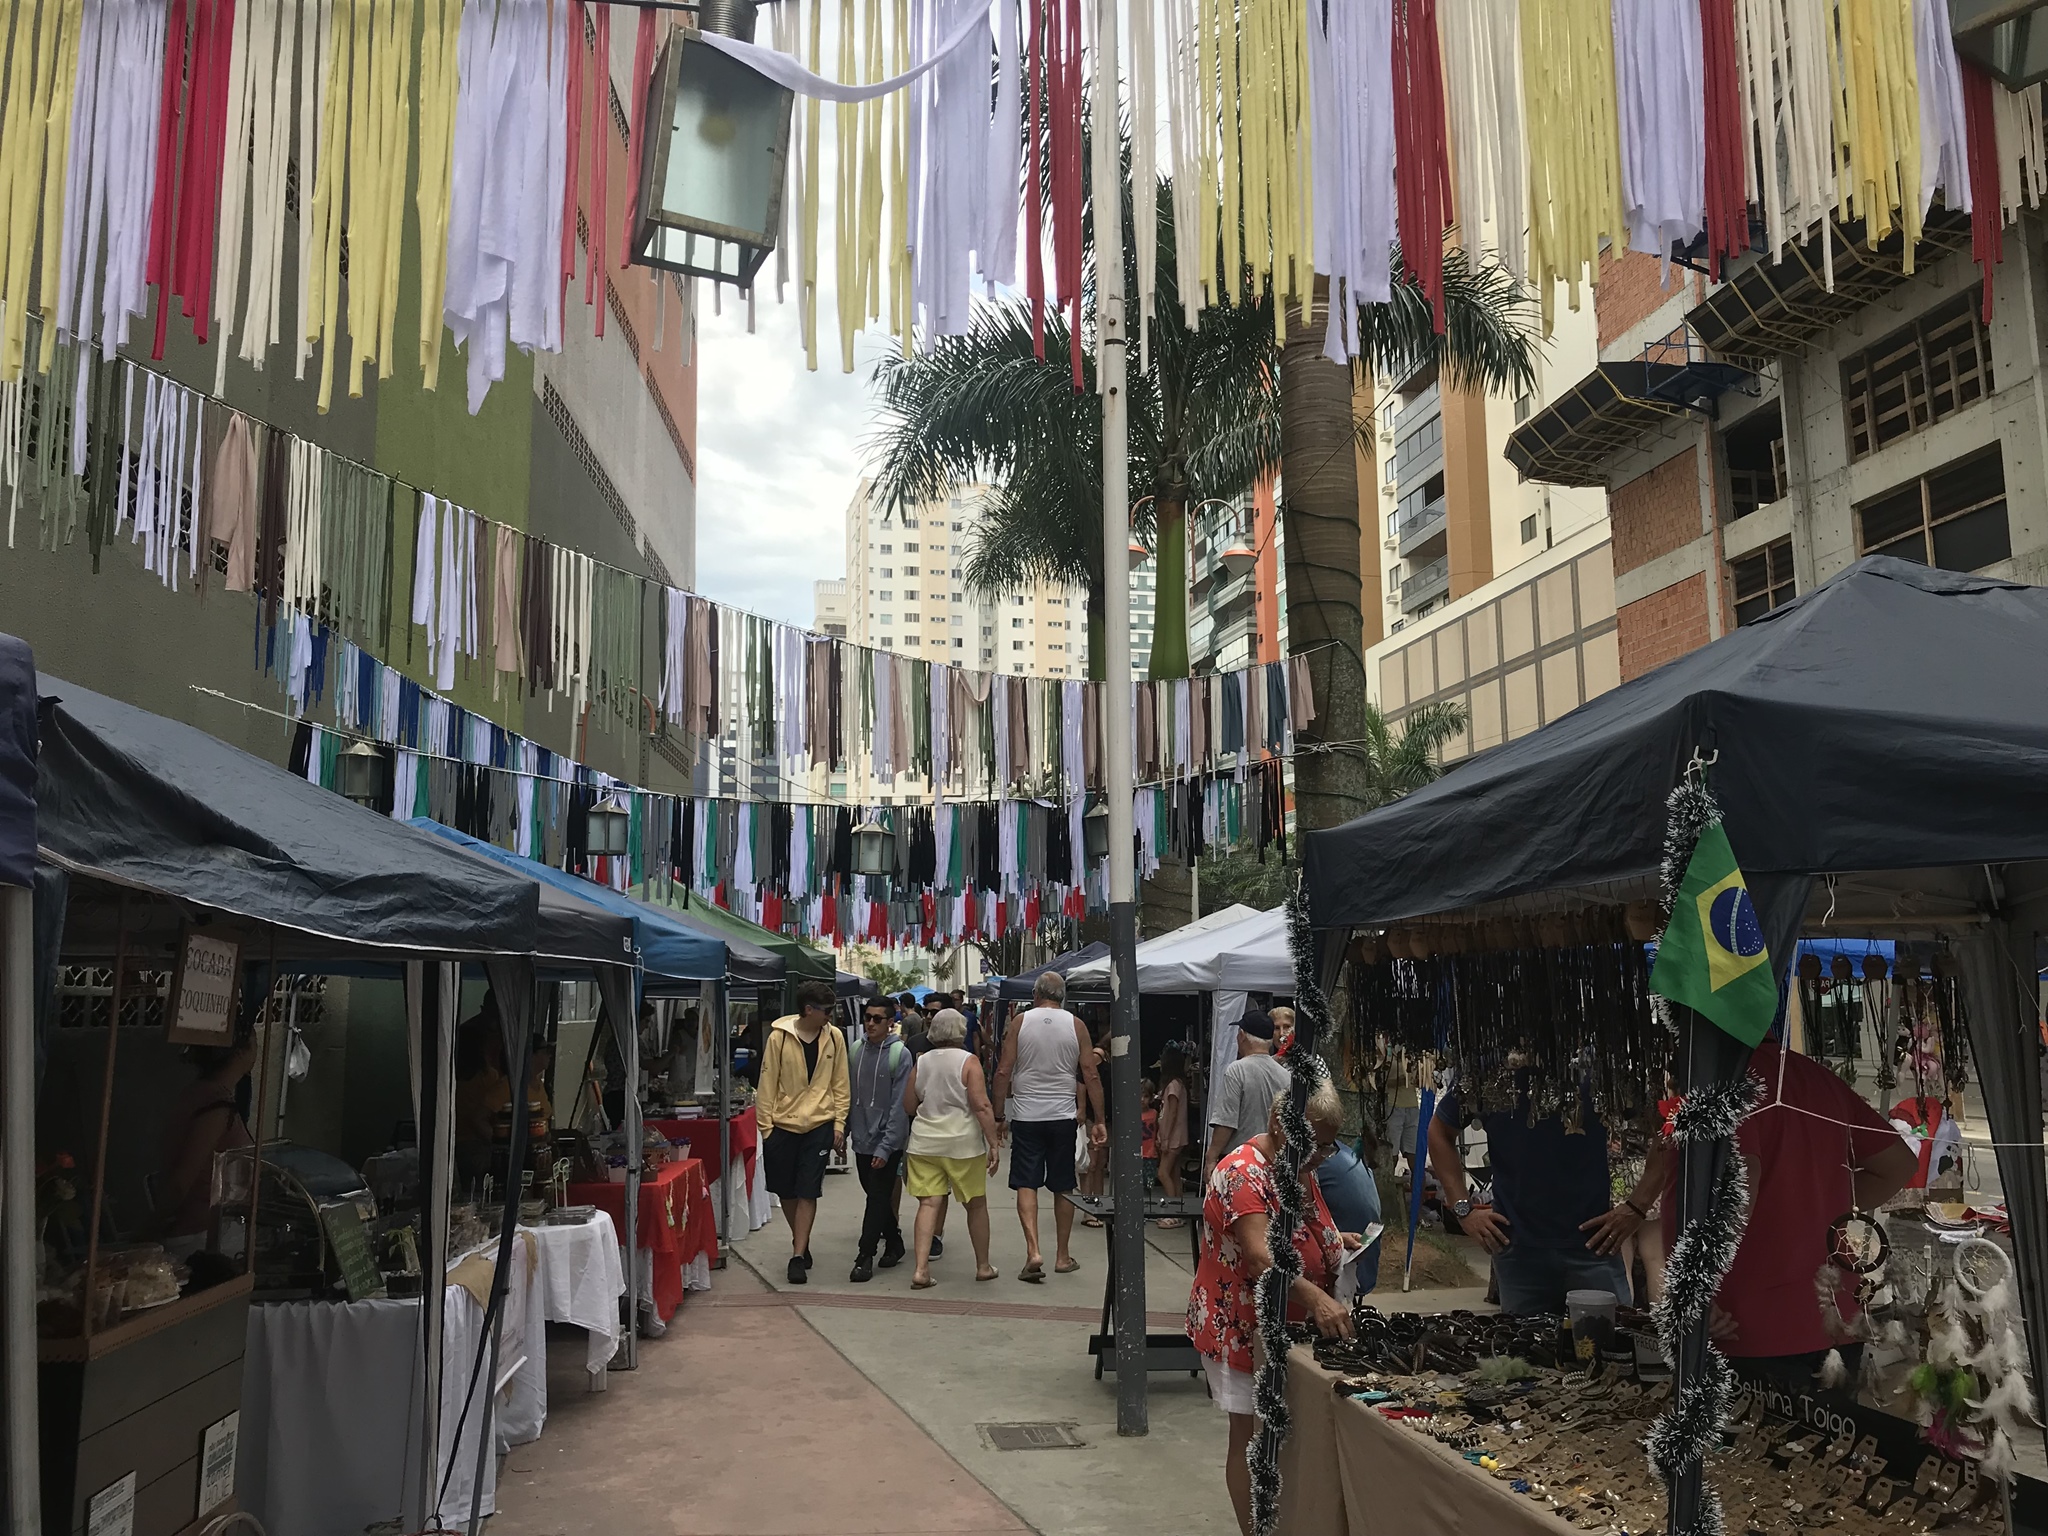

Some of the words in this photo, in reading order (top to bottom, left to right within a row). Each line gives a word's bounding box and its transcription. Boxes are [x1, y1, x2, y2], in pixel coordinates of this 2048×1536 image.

[186, 947, 232, 976] COCADA
[180, 988, 230, 1015] COQUINHO
[1729, 1369, 1793, 1417] Bethina
[1799, 1395, 1856, 1441] Toigo
